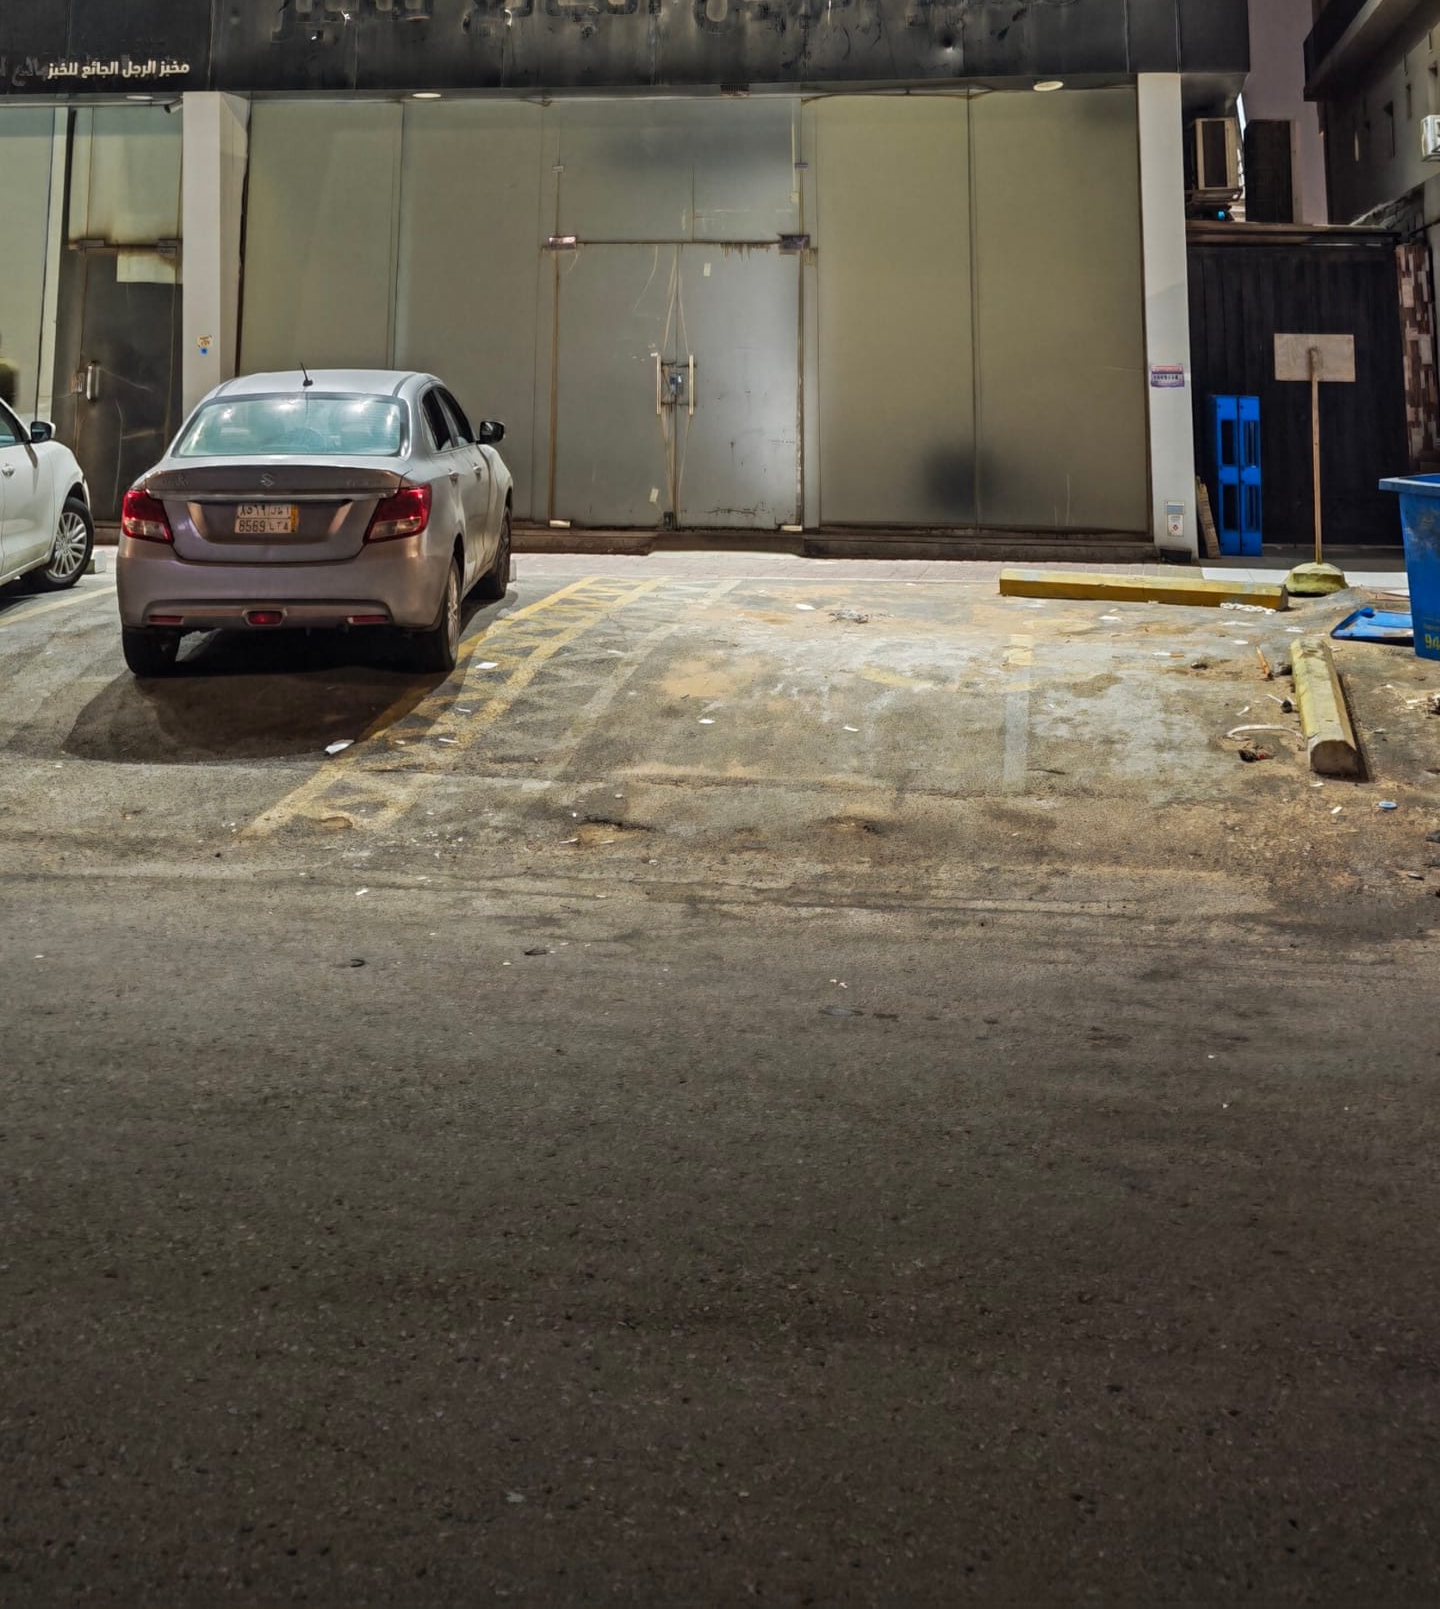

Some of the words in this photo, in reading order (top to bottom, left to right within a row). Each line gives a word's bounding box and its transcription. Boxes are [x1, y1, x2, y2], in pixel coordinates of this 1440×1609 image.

[47, 62, 78, 80] للخبز
[81, 61, 119, 79] الجائع
[122, 59, 156, 78] الرجل
[159, 60, 190, 78] مخبز
[239, 520, 266, 532] 8569
